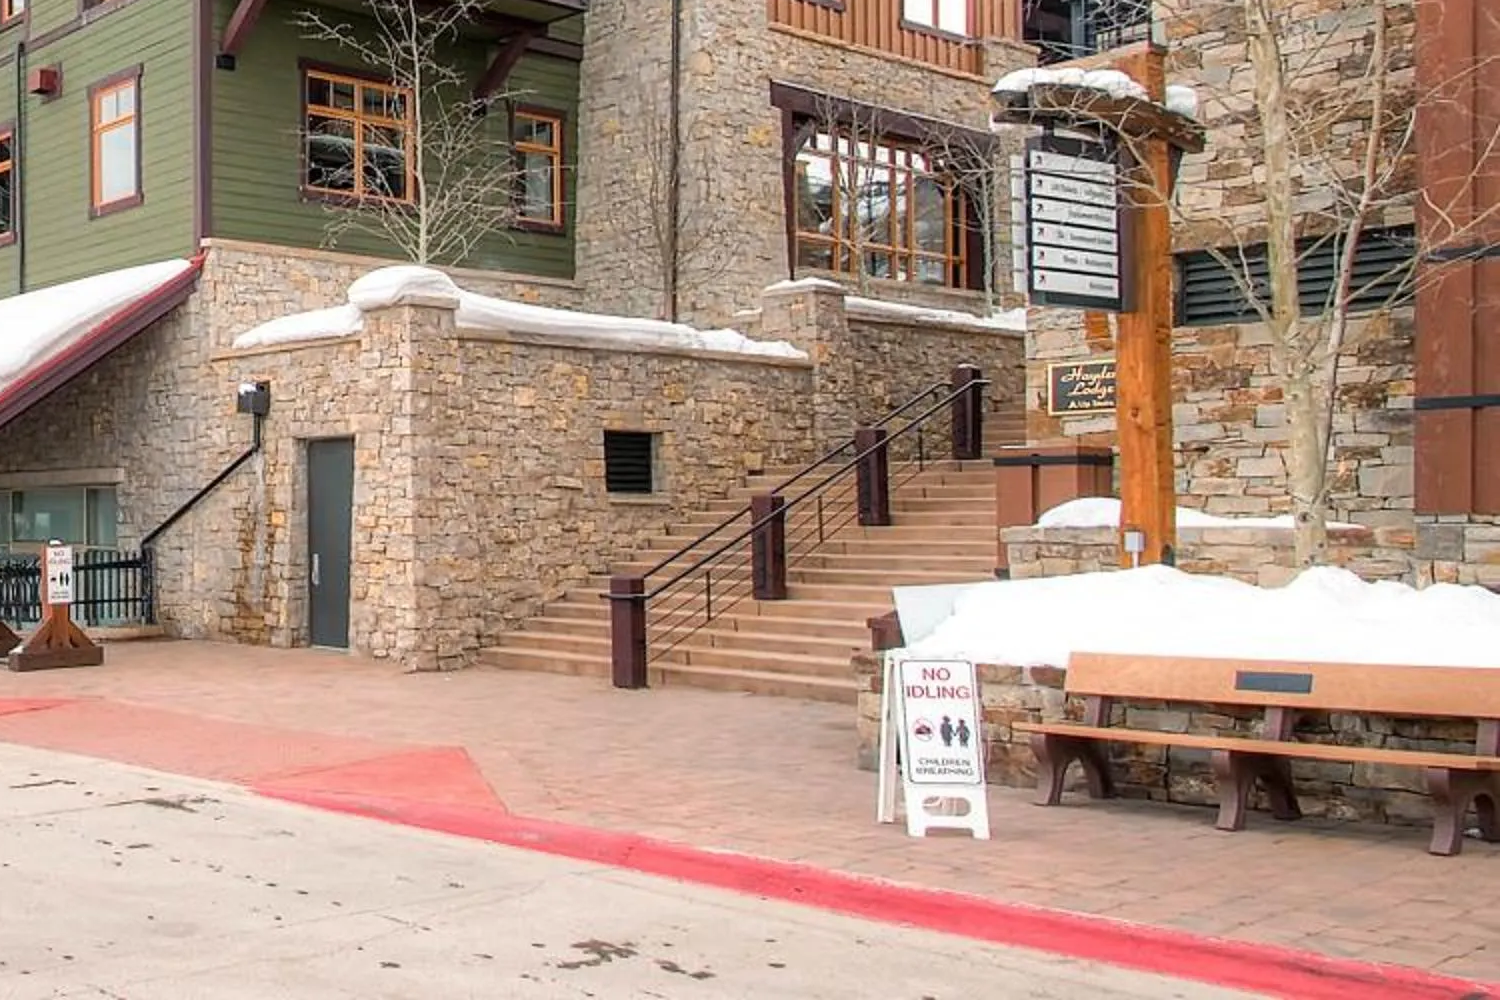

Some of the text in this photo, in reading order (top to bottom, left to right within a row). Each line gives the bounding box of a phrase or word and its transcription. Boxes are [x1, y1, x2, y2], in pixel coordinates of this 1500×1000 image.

[1061, 365, 1117, 386] Hayde
[1067, 380, 1116, 399] Lodge
[922, 667, 951, 681] NO
[906, 685, 971, 699] IDLING
